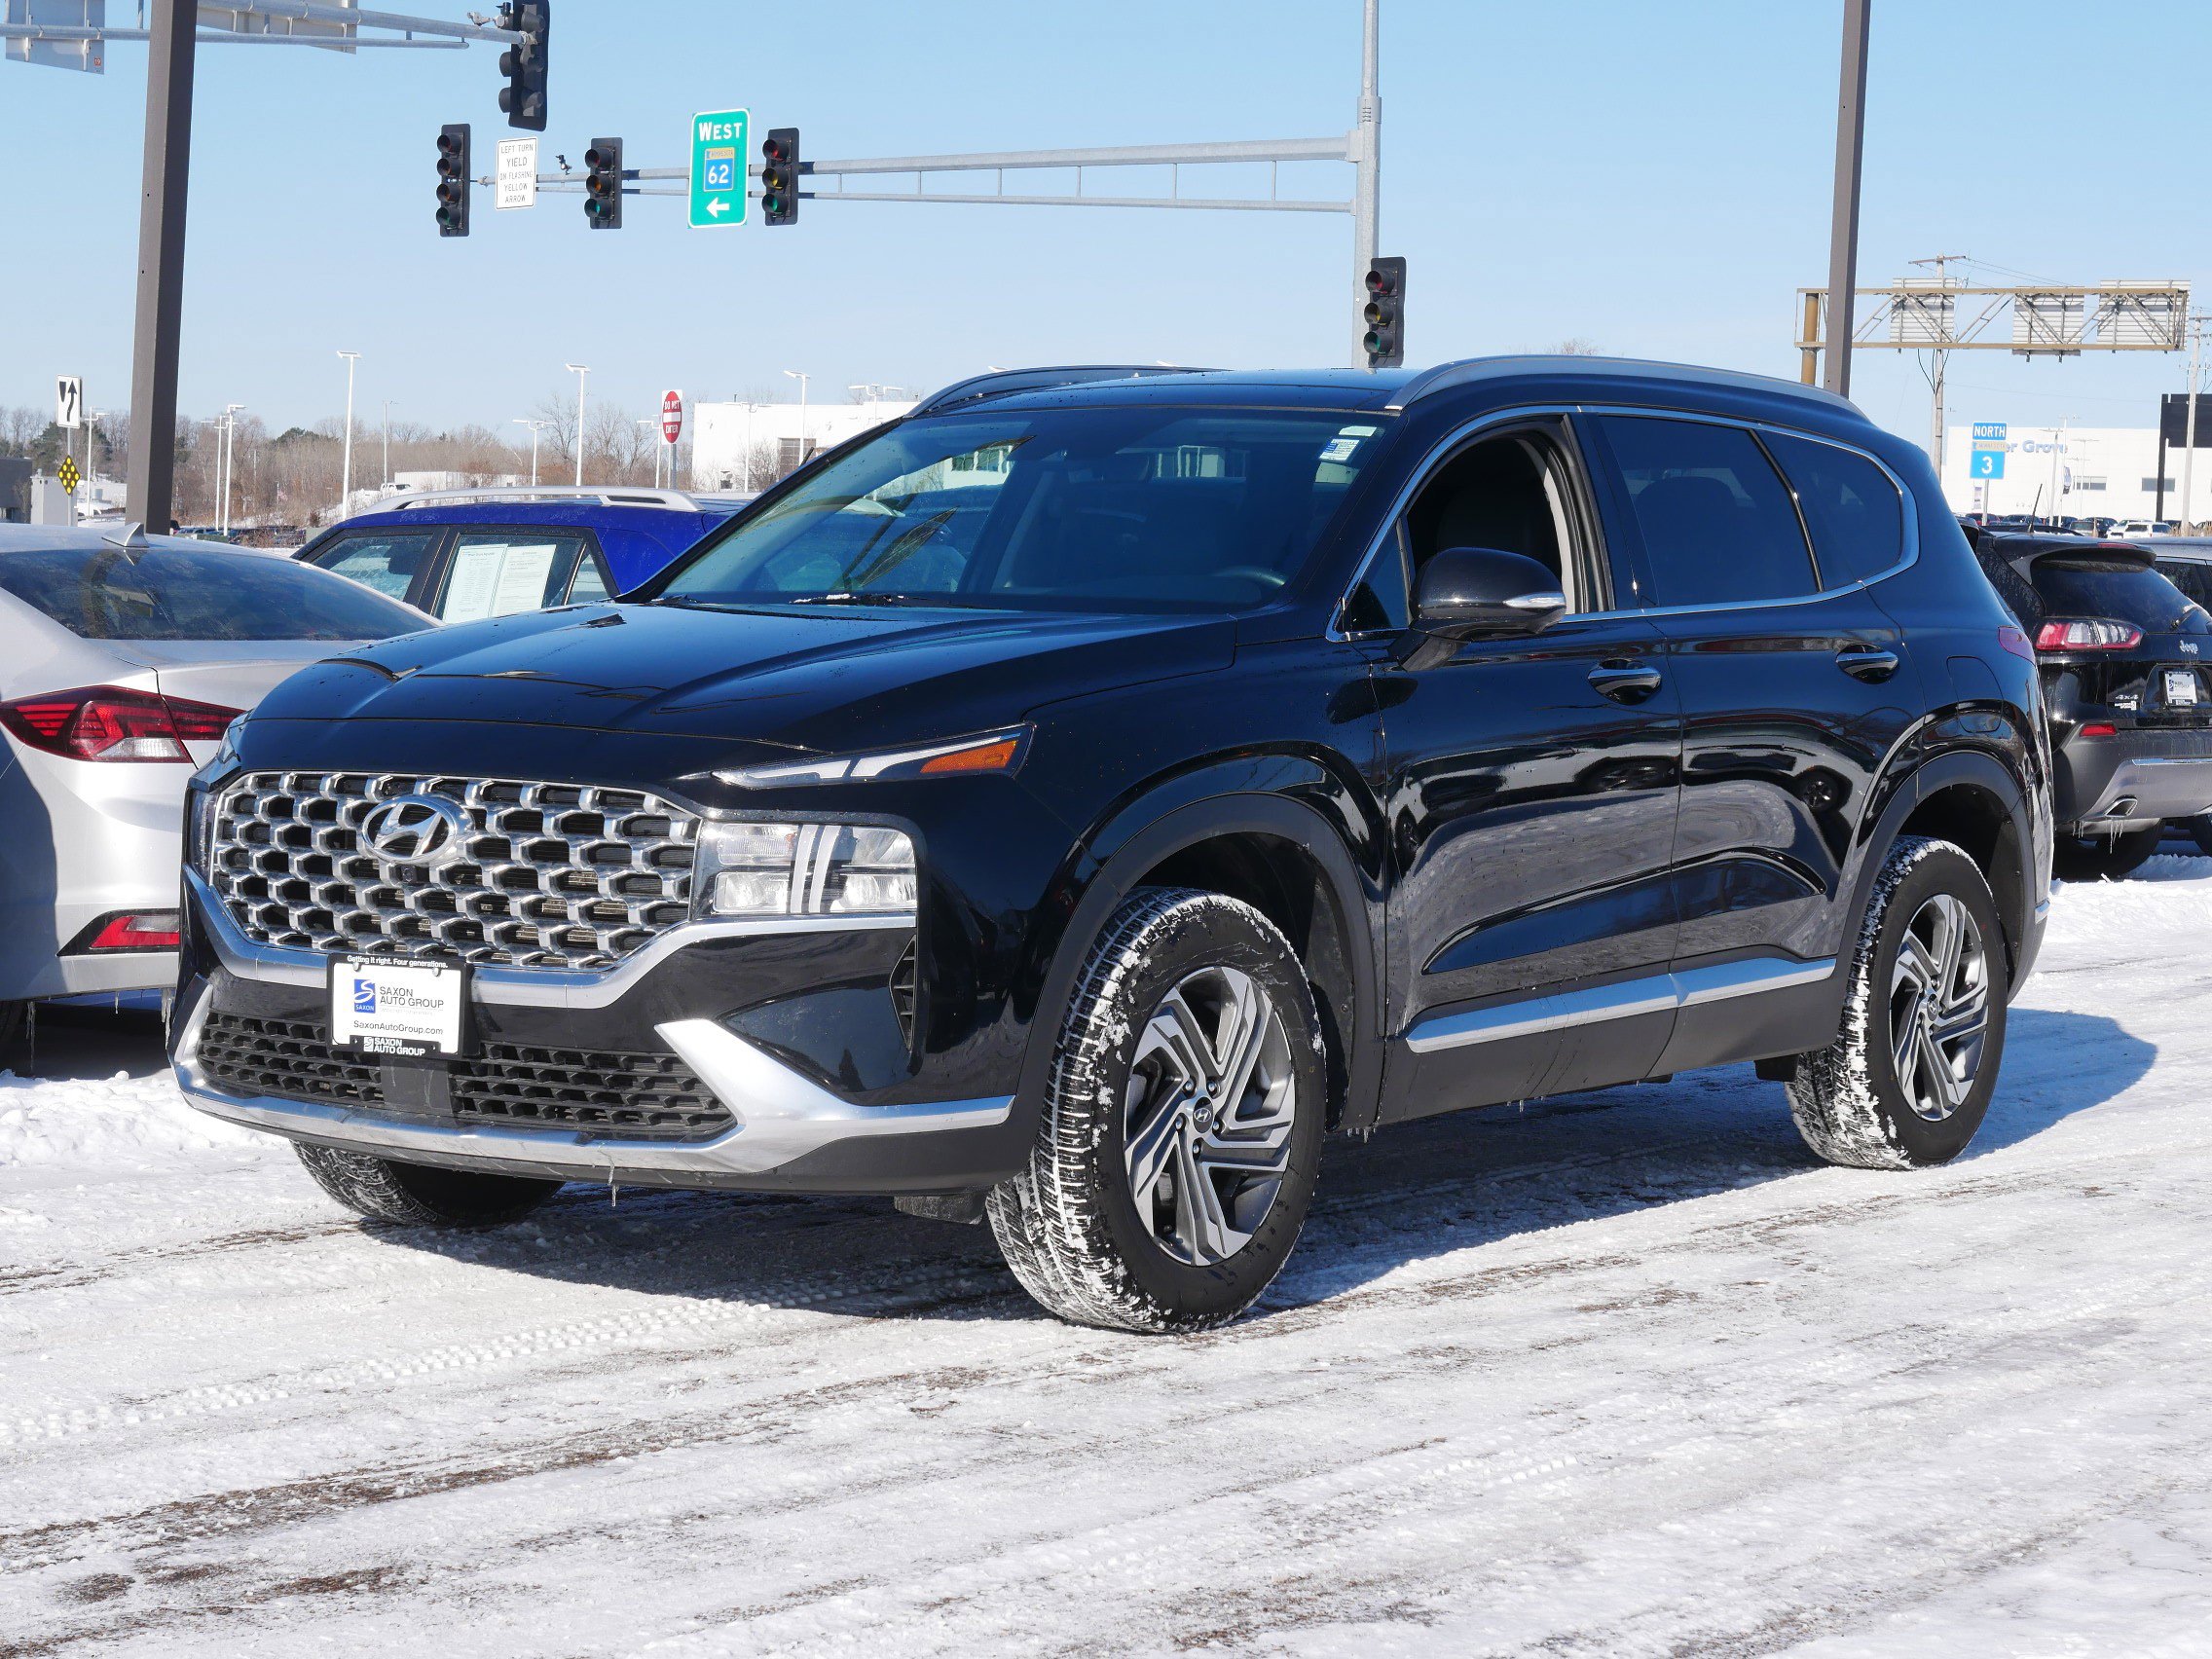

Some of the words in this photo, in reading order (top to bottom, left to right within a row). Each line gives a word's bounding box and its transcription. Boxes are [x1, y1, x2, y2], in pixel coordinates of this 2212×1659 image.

[698, 122, 743, 141] WEST
[500, 145, 515, 154] LEFT
[518, 143, 534, 152] TURN
[506, 157, 528, 167] YIELD
[499, 172, 507, 181] ON
[508, 170, 534, 180] FLASHING
[708, 164, 729, 184] 62
[504, 182, 528, 192] YELLOW
[505, 194, 526, 203] ARROW
[664, 400, 671, 410] DO
[671, 399, 680, 409] NOT
[665, 424, 679, 433] ENTER
[1973, 425, 2006, 437] NORTH
[1981, 456, 1993, 474] 3
[347, 955, 370, 964] Getting
[376, 957, 392, 966] right.
[409, 960, 448, 969] generations.
[380, 985, 413, 997] SAXON
[380, 996, 406, 1006] AUTO
[408, 997, 444, 1008] GROUP
[353, 1020, 443, 1034] SaxonAutoGroup.com
[374, 1037, 402, 1047] SAXON
[374, 1045, 395, 1053] AUTO
[396, 1047, 425, 1056] GROUP
